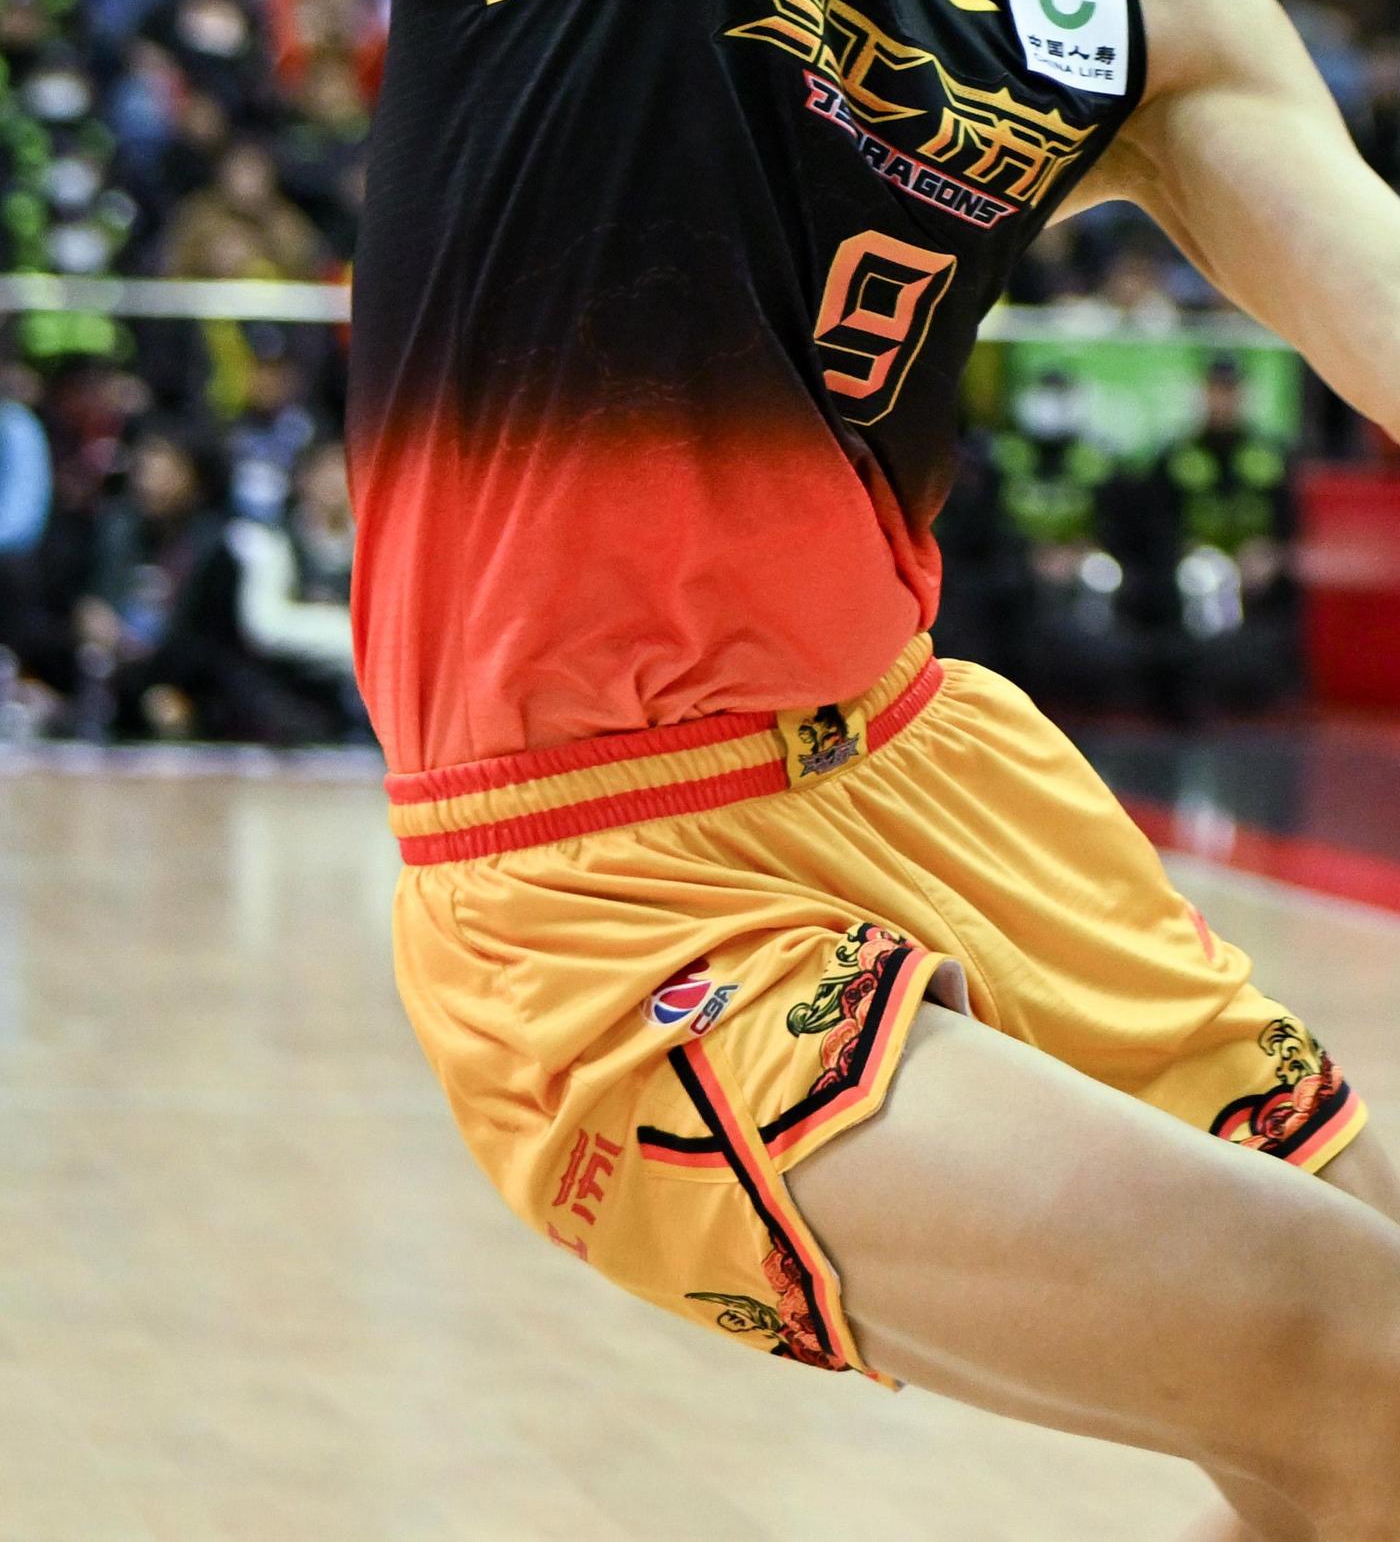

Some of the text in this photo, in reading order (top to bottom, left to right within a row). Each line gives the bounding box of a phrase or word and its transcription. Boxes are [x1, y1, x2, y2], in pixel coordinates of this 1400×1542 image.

[1026, 34, 1116, 65] 中国人寿
[1079, 66, 1114, 81] LIFE
[813, 229, 957, 426] 9
[689, 984, 739, 1035] CBA
